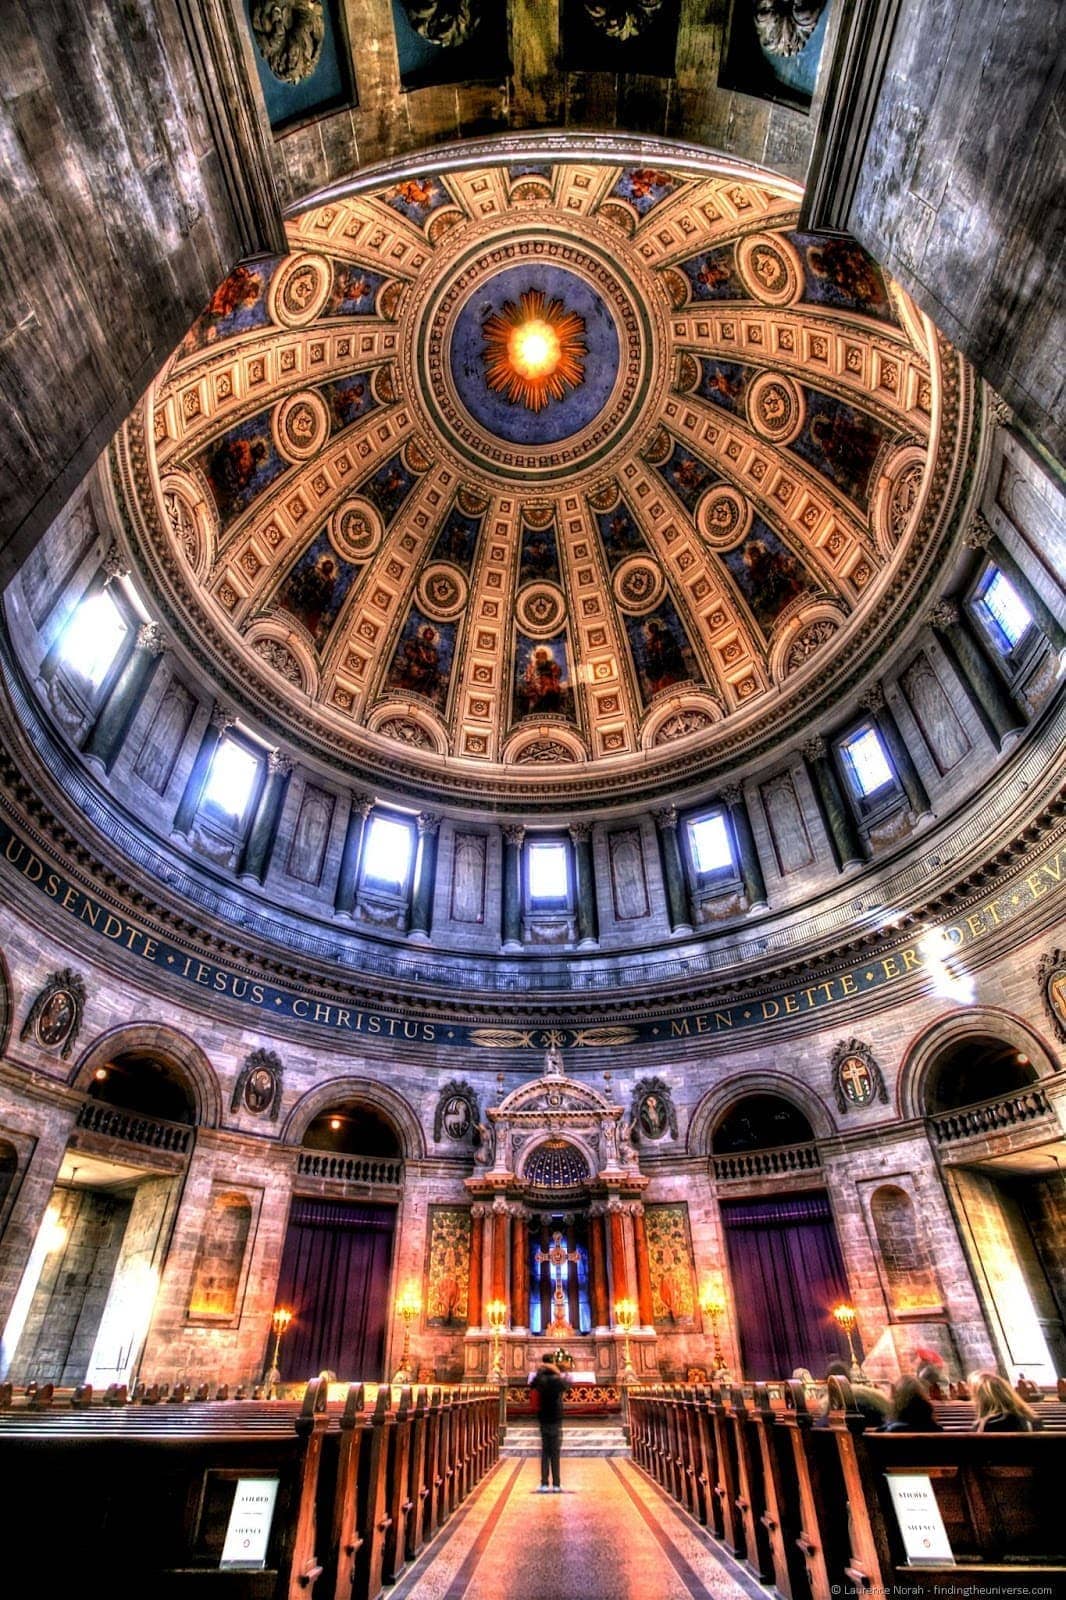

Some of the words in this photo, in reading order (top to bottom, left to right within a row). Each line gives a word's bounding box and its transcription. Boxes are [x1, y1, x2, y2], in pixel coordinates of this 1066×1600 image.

[6, 836, 159, 961] UDSENDTE
[292, 998, 436, 1041] CHRISTUS
[670, 1010, 733, 1037] MEN
[760, 974, 858, 1020] DETTE
[882, 949, 925, 981] ER
[943, 898, 1004, 947] DET
